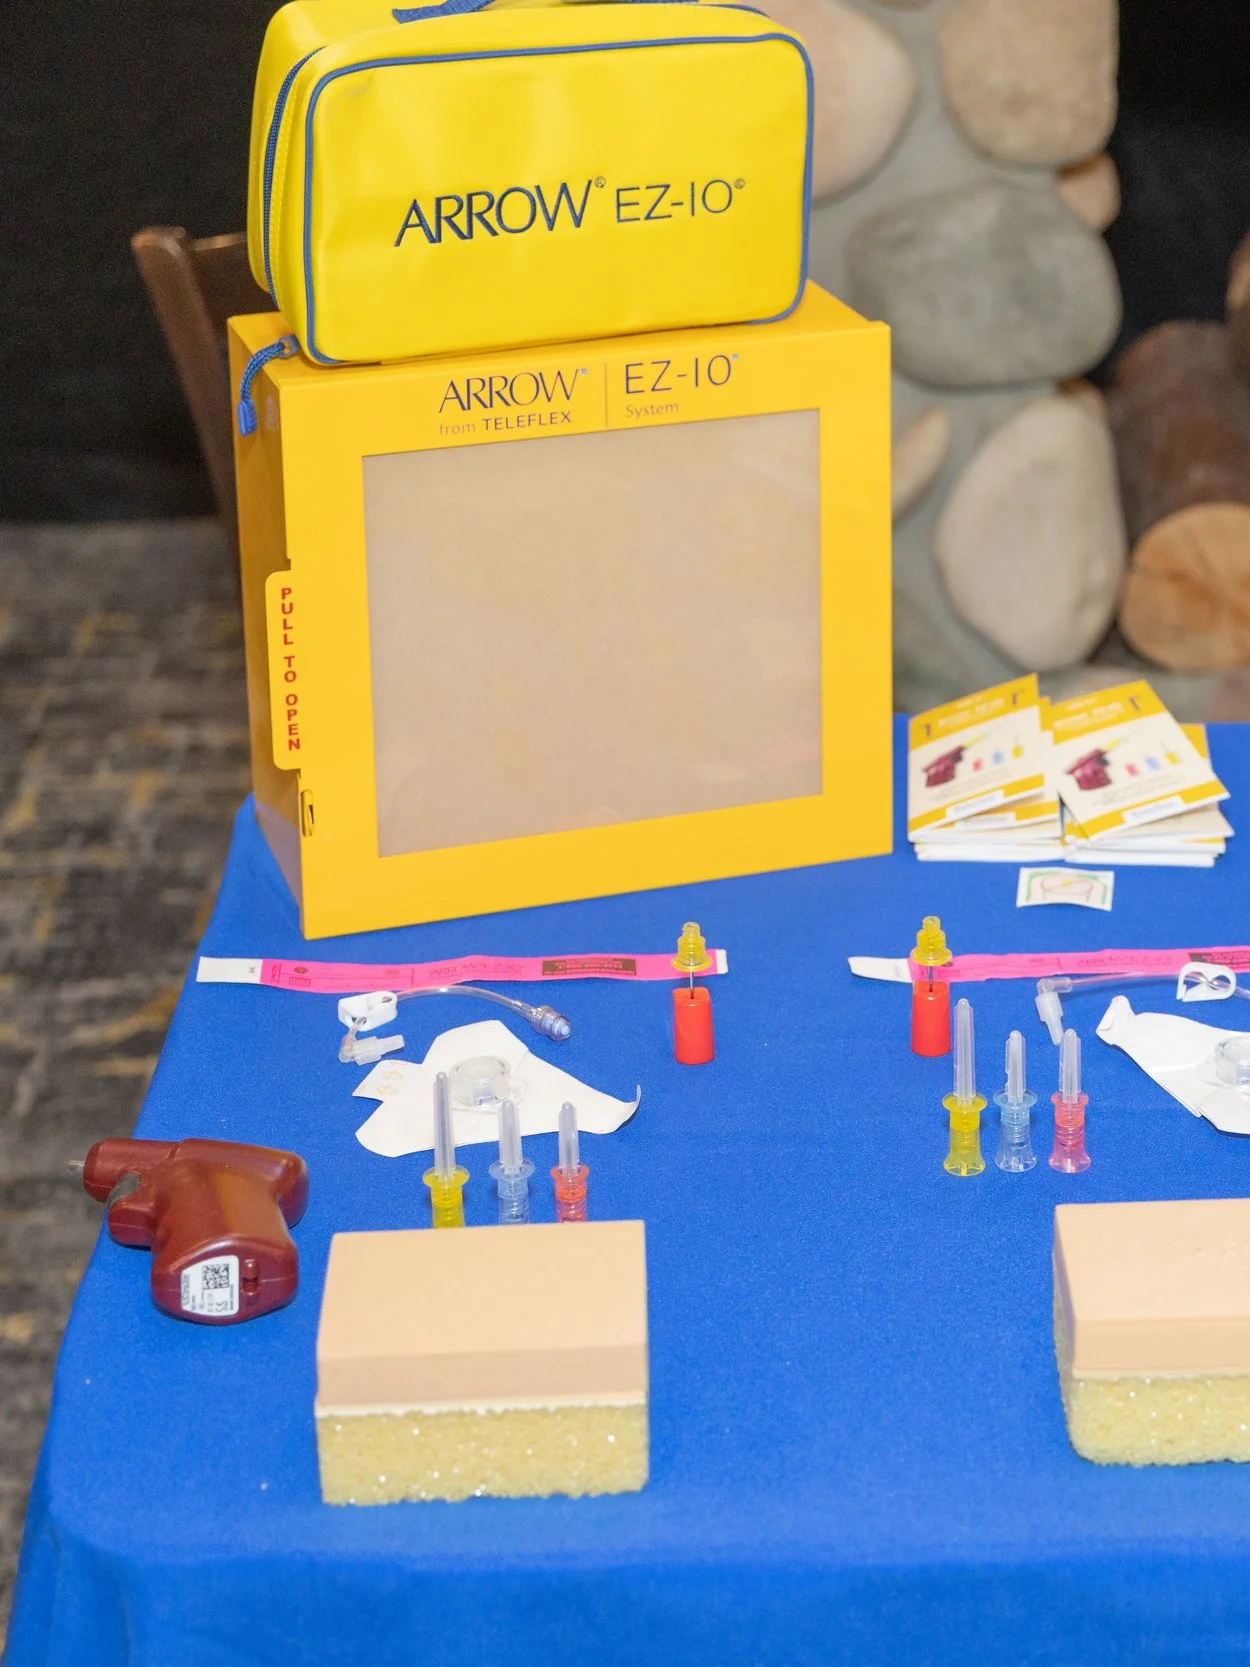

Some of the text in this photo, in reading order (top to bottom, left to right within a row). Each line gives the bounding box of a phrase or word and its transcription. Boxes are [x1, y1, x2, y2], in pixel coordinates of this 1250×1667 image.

[439, 410, 572, 436] from TELEFLEX
[625, 402, 680, 419] System
[281, 587, 294, 645] PULL
[283, 656, 297, 683] TO
[285, 693, 301, 751] OPEN
